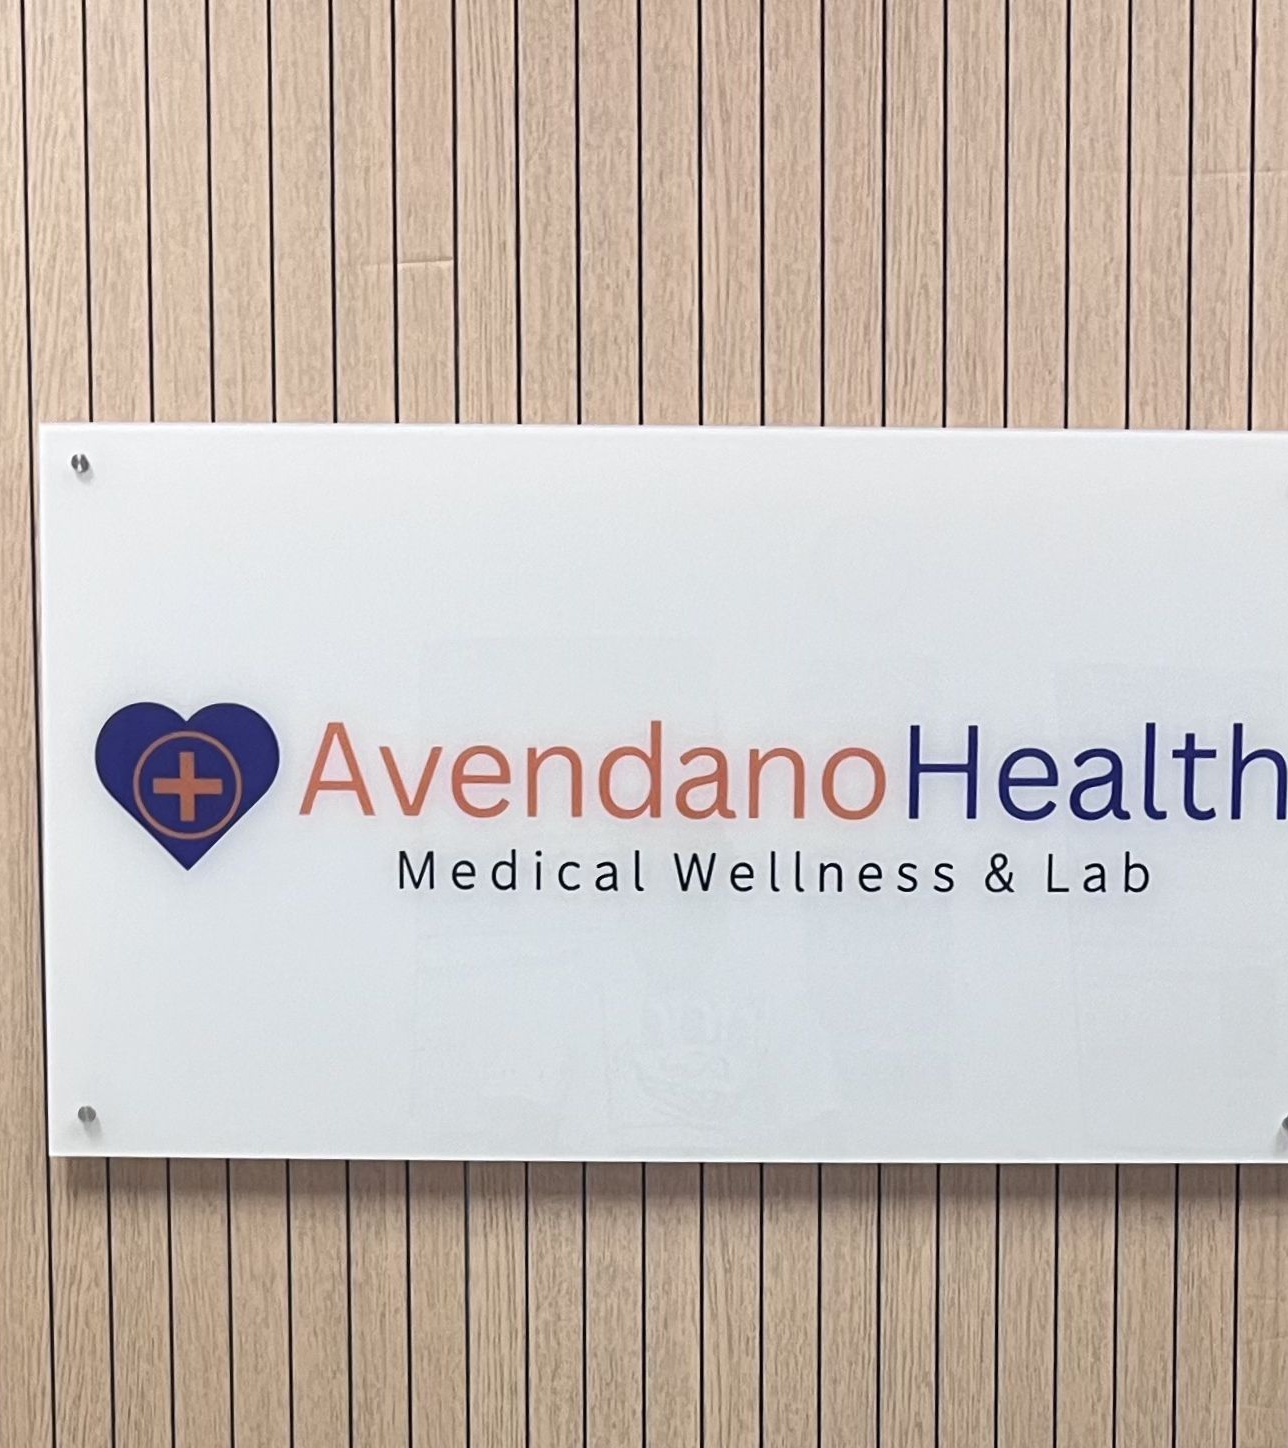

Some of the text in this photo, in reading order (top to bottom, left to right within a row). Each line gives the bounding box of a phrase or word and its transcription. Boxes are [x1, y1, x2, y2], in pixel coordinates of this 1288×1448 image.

[399, 849, 1149, 893] Medical Wellness & Lab
